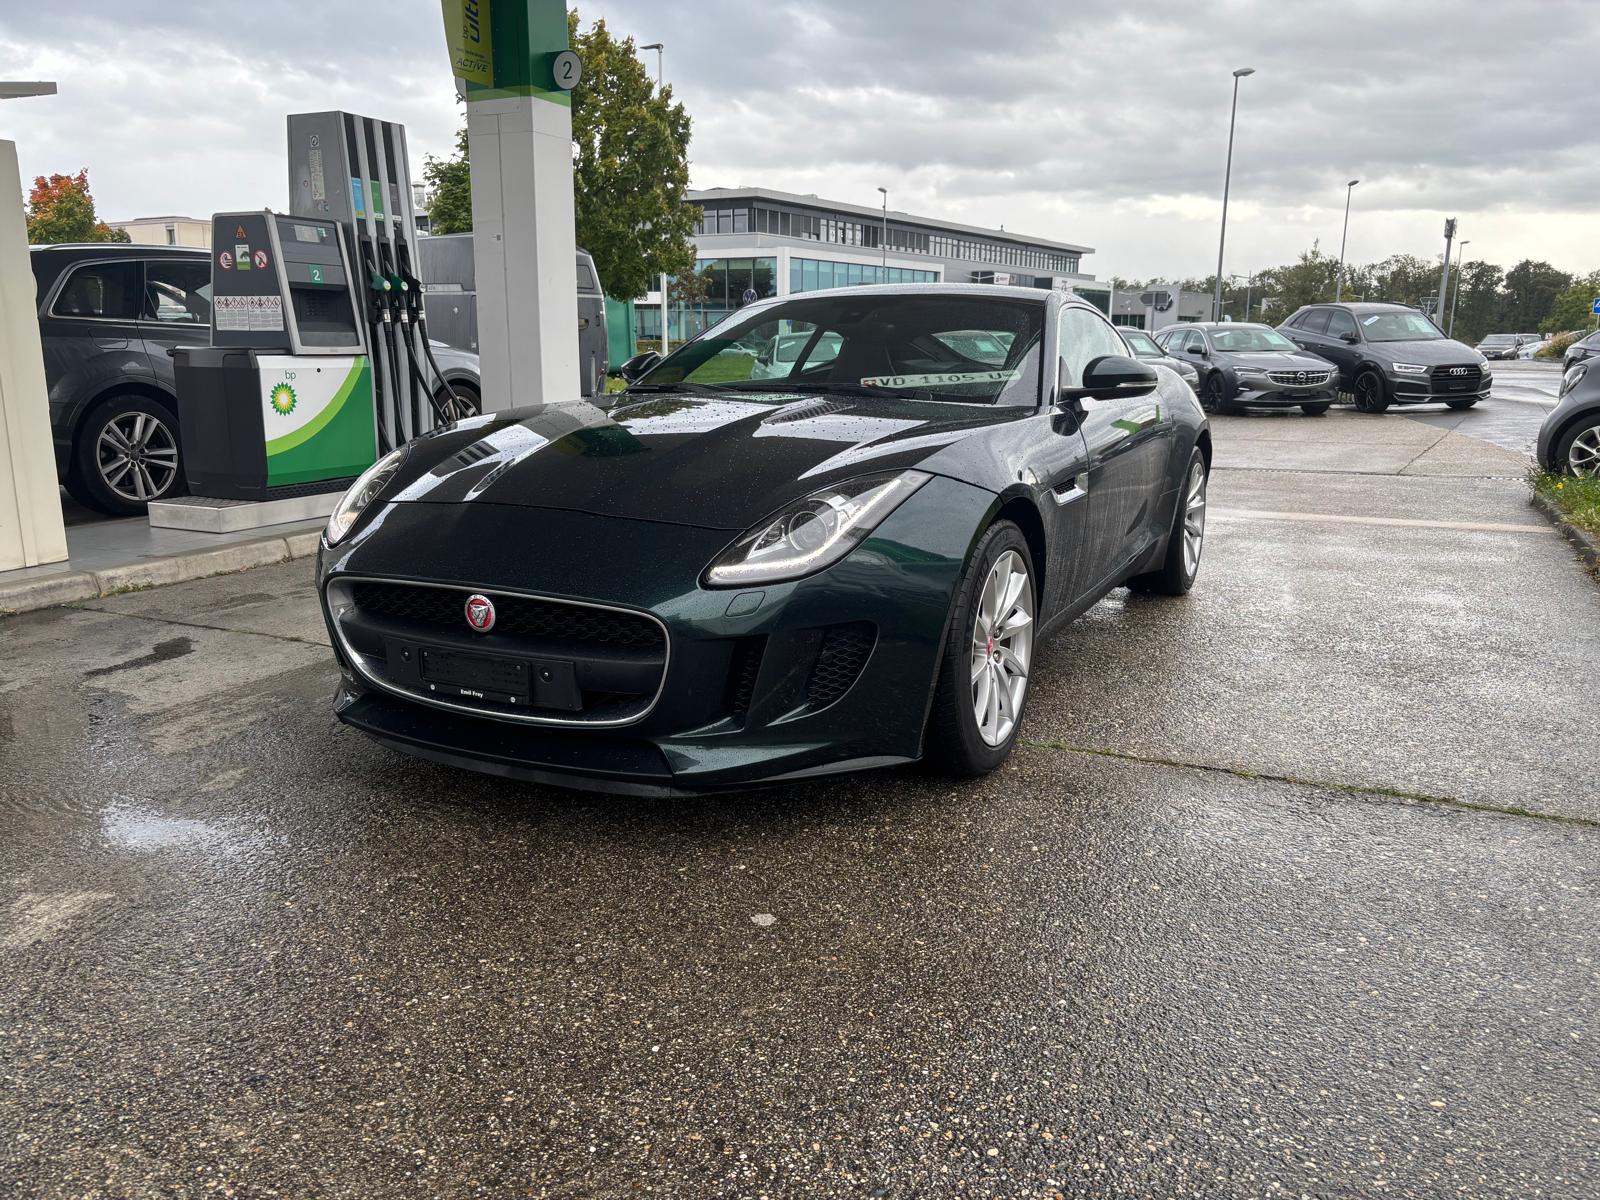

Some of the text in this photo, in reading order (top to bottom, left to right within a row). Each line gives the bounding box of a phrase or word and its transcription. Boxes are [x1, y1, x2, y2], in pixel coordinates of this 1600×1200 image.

[456, 58, 489, 72] ACTIVE
[563, 60, 572, 80] 2
[312, 269, 321, 281] 2
[284, 370, 297, 381] bp
[472, 690, 484, 698] Frey
